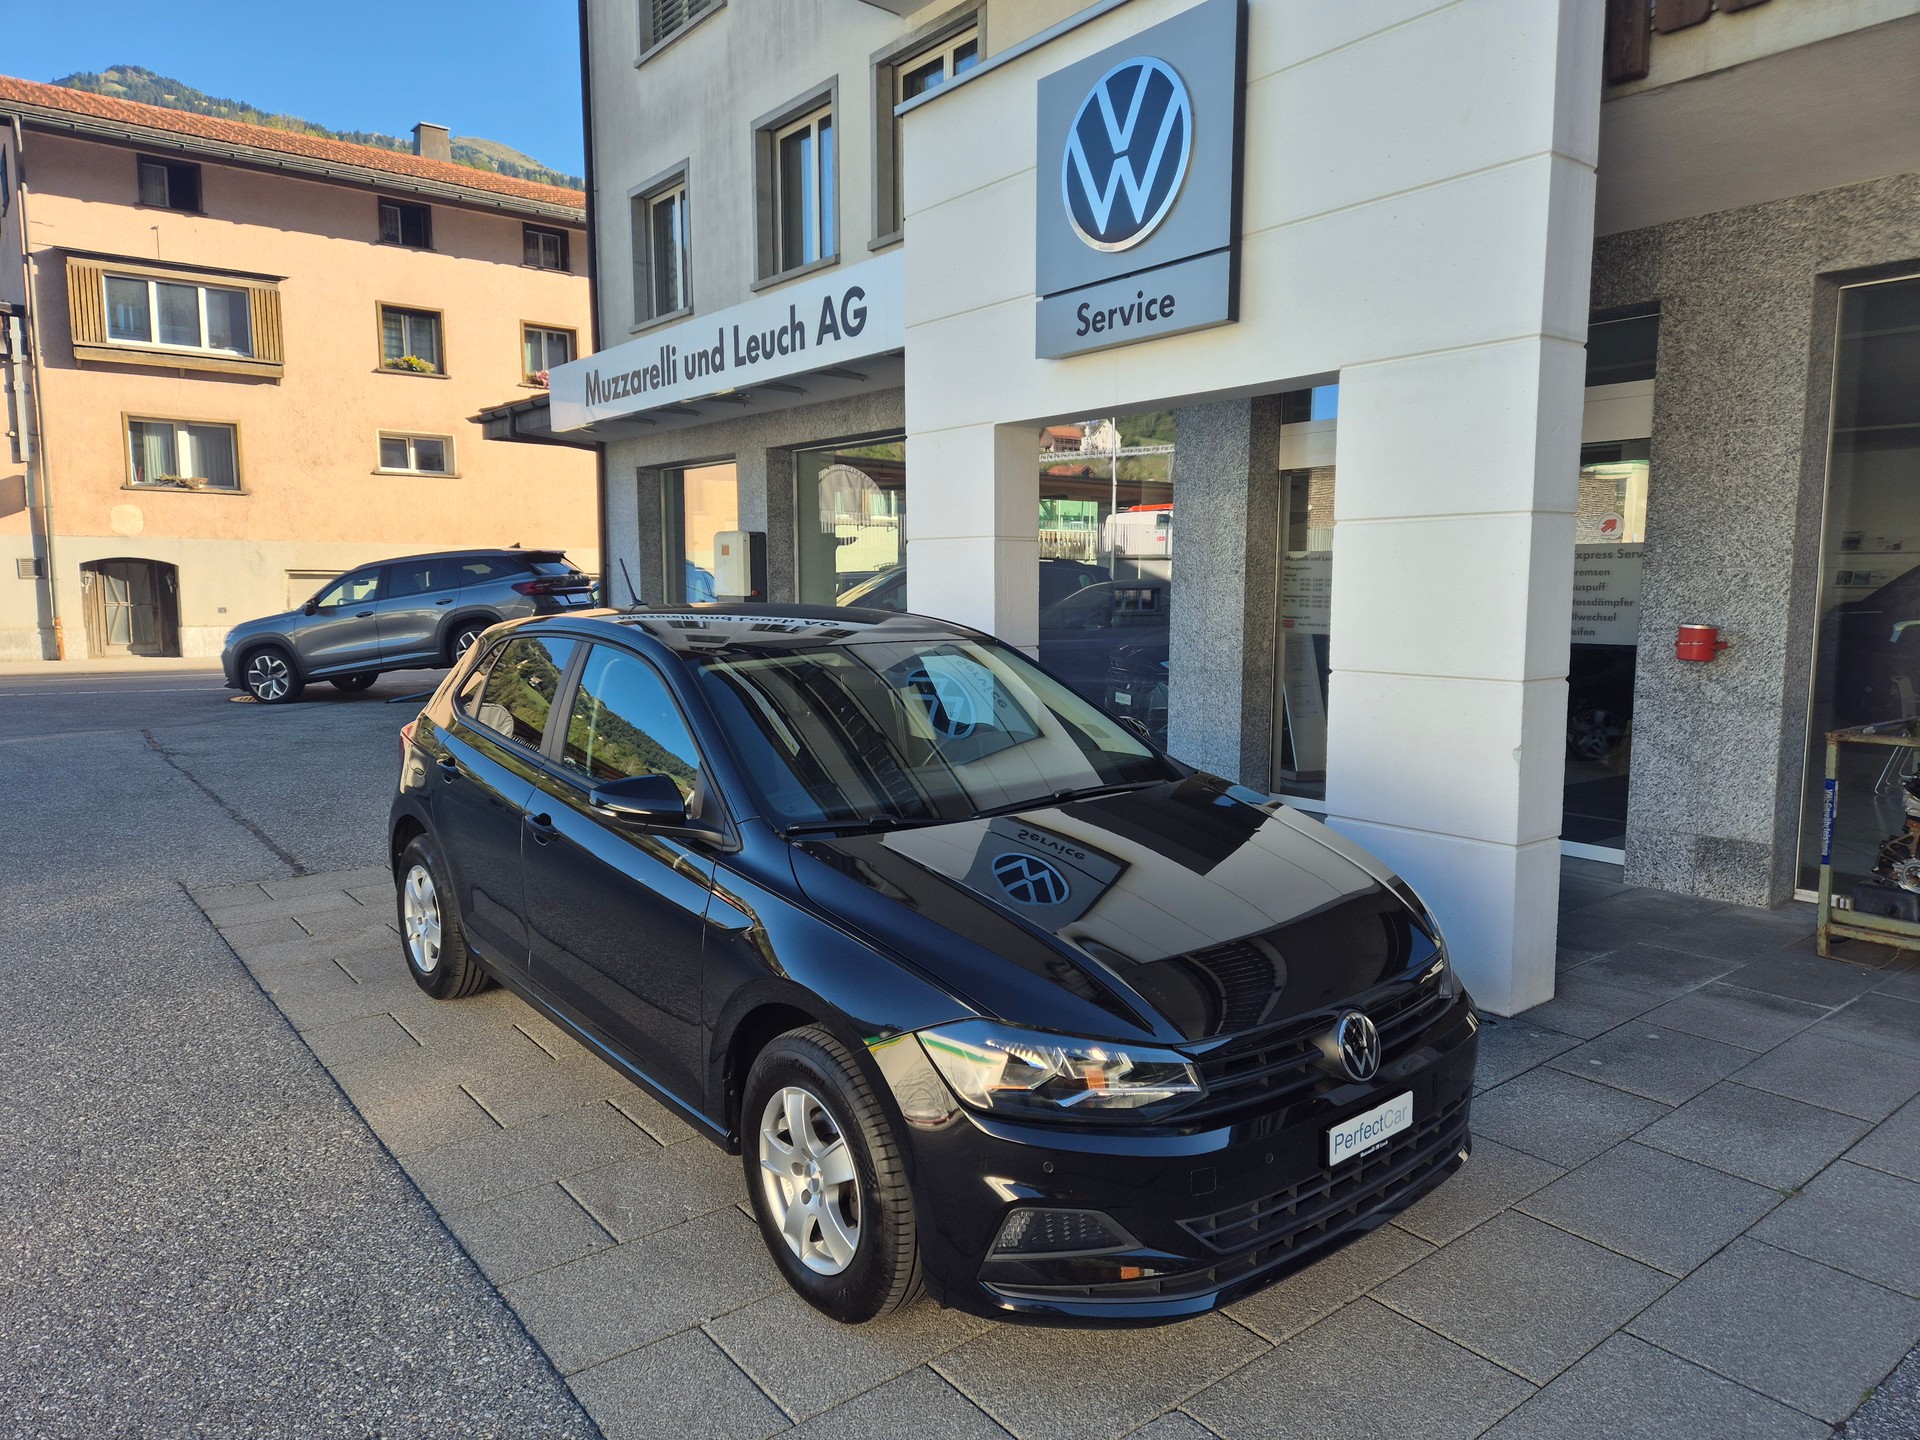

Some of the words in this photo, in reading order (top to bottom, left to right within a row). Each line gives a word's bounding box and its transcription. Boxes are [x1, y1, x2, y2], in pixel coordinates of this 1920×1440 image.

[1075, 289, 1176, 337] Service
[585, 344, 678, 408] Muzzarelli
[684, 327, 725, 381] und
[733, 304, 806, 368] Leuch
[815, 285, 868, 346] AG
[1575, 549, 1613, 561] xpress
[1572, 582, 1606, 593] uspuff
[1573, 569, 1611, 577] remsen
[776, 1055, 826, 1088] UltraContact
[1334, 1105, 1408, 1155] PerfectCar
